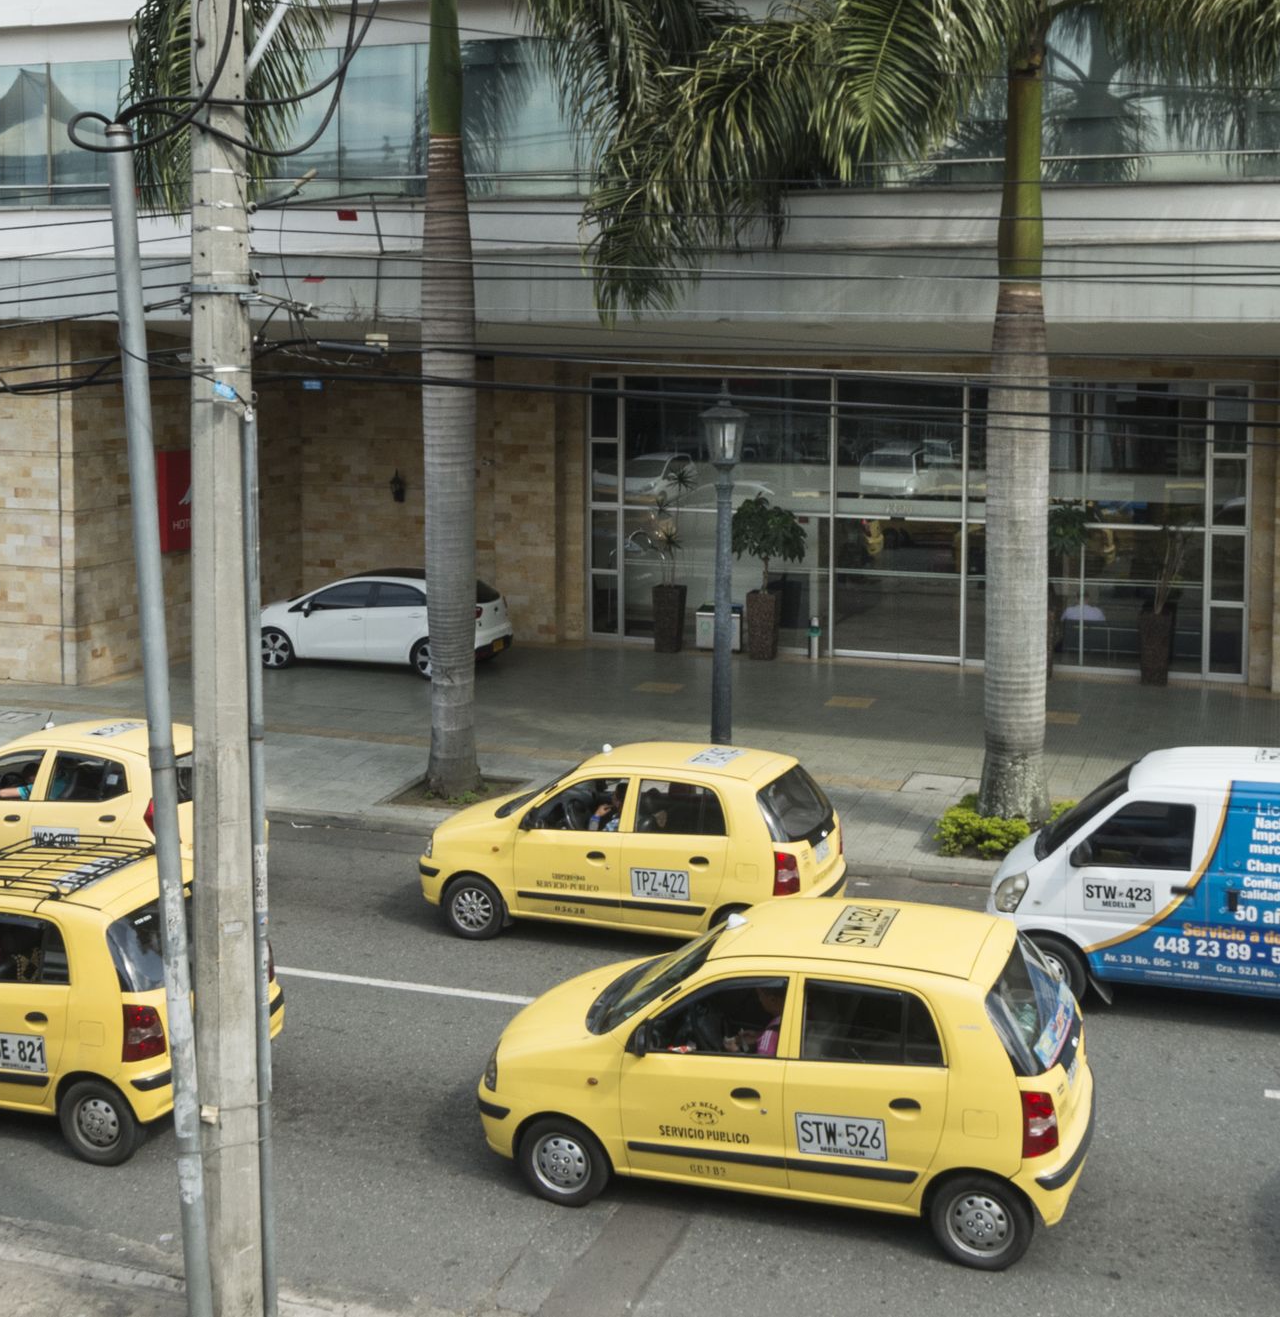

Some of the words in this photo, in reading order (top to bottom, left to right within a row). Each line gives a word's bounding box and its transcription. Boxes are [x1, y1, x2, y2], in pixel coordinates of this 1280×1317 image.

[1240, 889, 1280, 902] calidad
[1102, 900, 1136, 909] MEDELLIN
[1234, 905, 1258, 922] 50
[1183, 923, 1246, 941] Servicio
[1250, 932, 1260, 943] a
[1154, 936, 1190, 954] 448
[1195, 939, 1220, 957] 23
[1226, 942, 1251, 960] 89
[1104, 953, 1118, 962] Av.
[1121, 955, 1132, 963] 33
[1135, 956, 1151, 965] No.
[1182, 960, 1200, 970] 128
[1216, 964, 1236, 974] Cra.
[1239, 966, 1258, 976] 52A
[1260, 969, 1277, 978] No.
[658, 1125, 705, 1140] SERVICIO
[706, 1130, 750, 1144] PUBLICO
[820, 1146, 865, 1156] MEDELLIN
